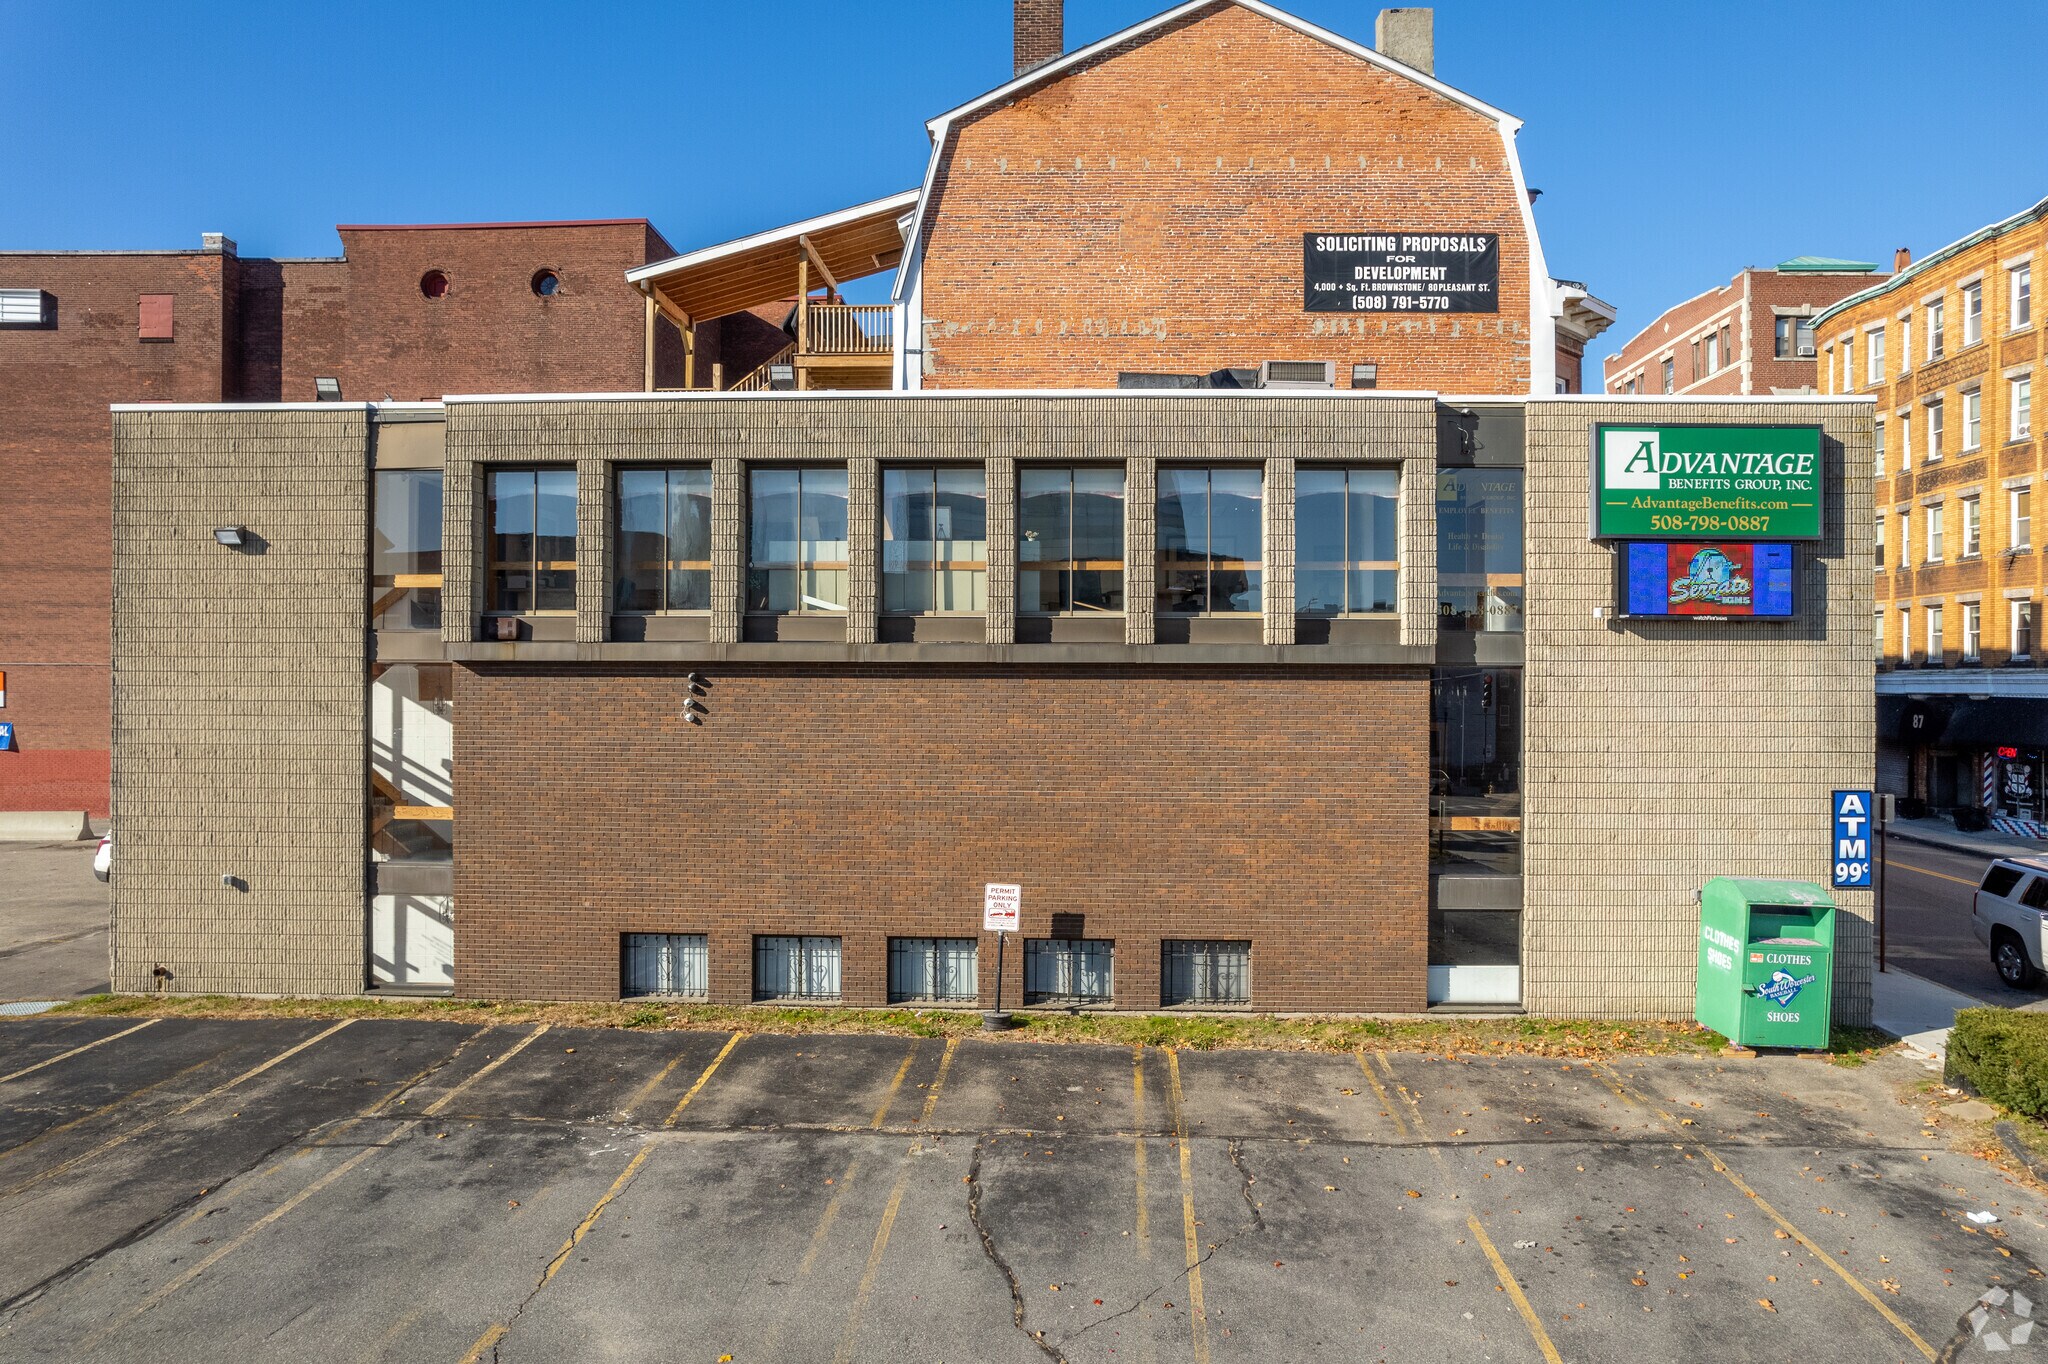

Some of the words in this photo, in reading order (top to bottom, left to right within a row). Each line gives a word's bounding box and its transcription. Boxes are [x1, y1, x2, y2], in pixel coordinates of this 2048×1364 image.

[1316, 236, 1396, 252] SOLICITING
[1402, 236, 1487, 252] PROPOSALS
[1386, 255, 1416, 263] FOR
[1354, 266, 1447, 280] DEVELOPMENT
[1313, 283, 1336, 292] 4,000
[1346, 283, 1358, 293] Sq.
[1360, 283, 1371, 291] Ft.
[1428, 283, 1438, 292] 80
[1438, 283, 1476, 292] PLEASANT
[1478, 284, 1490, 292] ST.
[1352, 295, 1386, 310] (508)
[1392, 296, 1449, 309] 791-5770
[1624, 441, 1814, 476] ADVANTAGE
[1668, 478, 1731, 489] BENEFITS
[1735, 479, 1782, 491] GROUP,
[1786, 479, 1813, 490] INC.
[1481, 507, 1515, 515] BENEFITS
[1631, 496, 1789, 512] AdvantageBenefits.com
[1650, 515, 1770, 532] 508-798-0887
[1448, 543, 1462, 551] Life
[1912, 714, 1924, 728] 87
[1998, 746, 2018, 758] OPEN
[1839, 794, 1866, 859] ATM
[1835, 862, 1869, 883] 99¢
[1704, 925, 1740, 954] CLOTHES
[1707, 947, 1732, 970] SHOES
[1766, 953, 1812, 965] CLOTHES
[1757, 982, 1779, 998] South
[1779, 975, 1815, 991] Worcester
[1770, 987, 1799, 999] BASEBALL
[1767, 1011, 1800, 1023] SHOES
